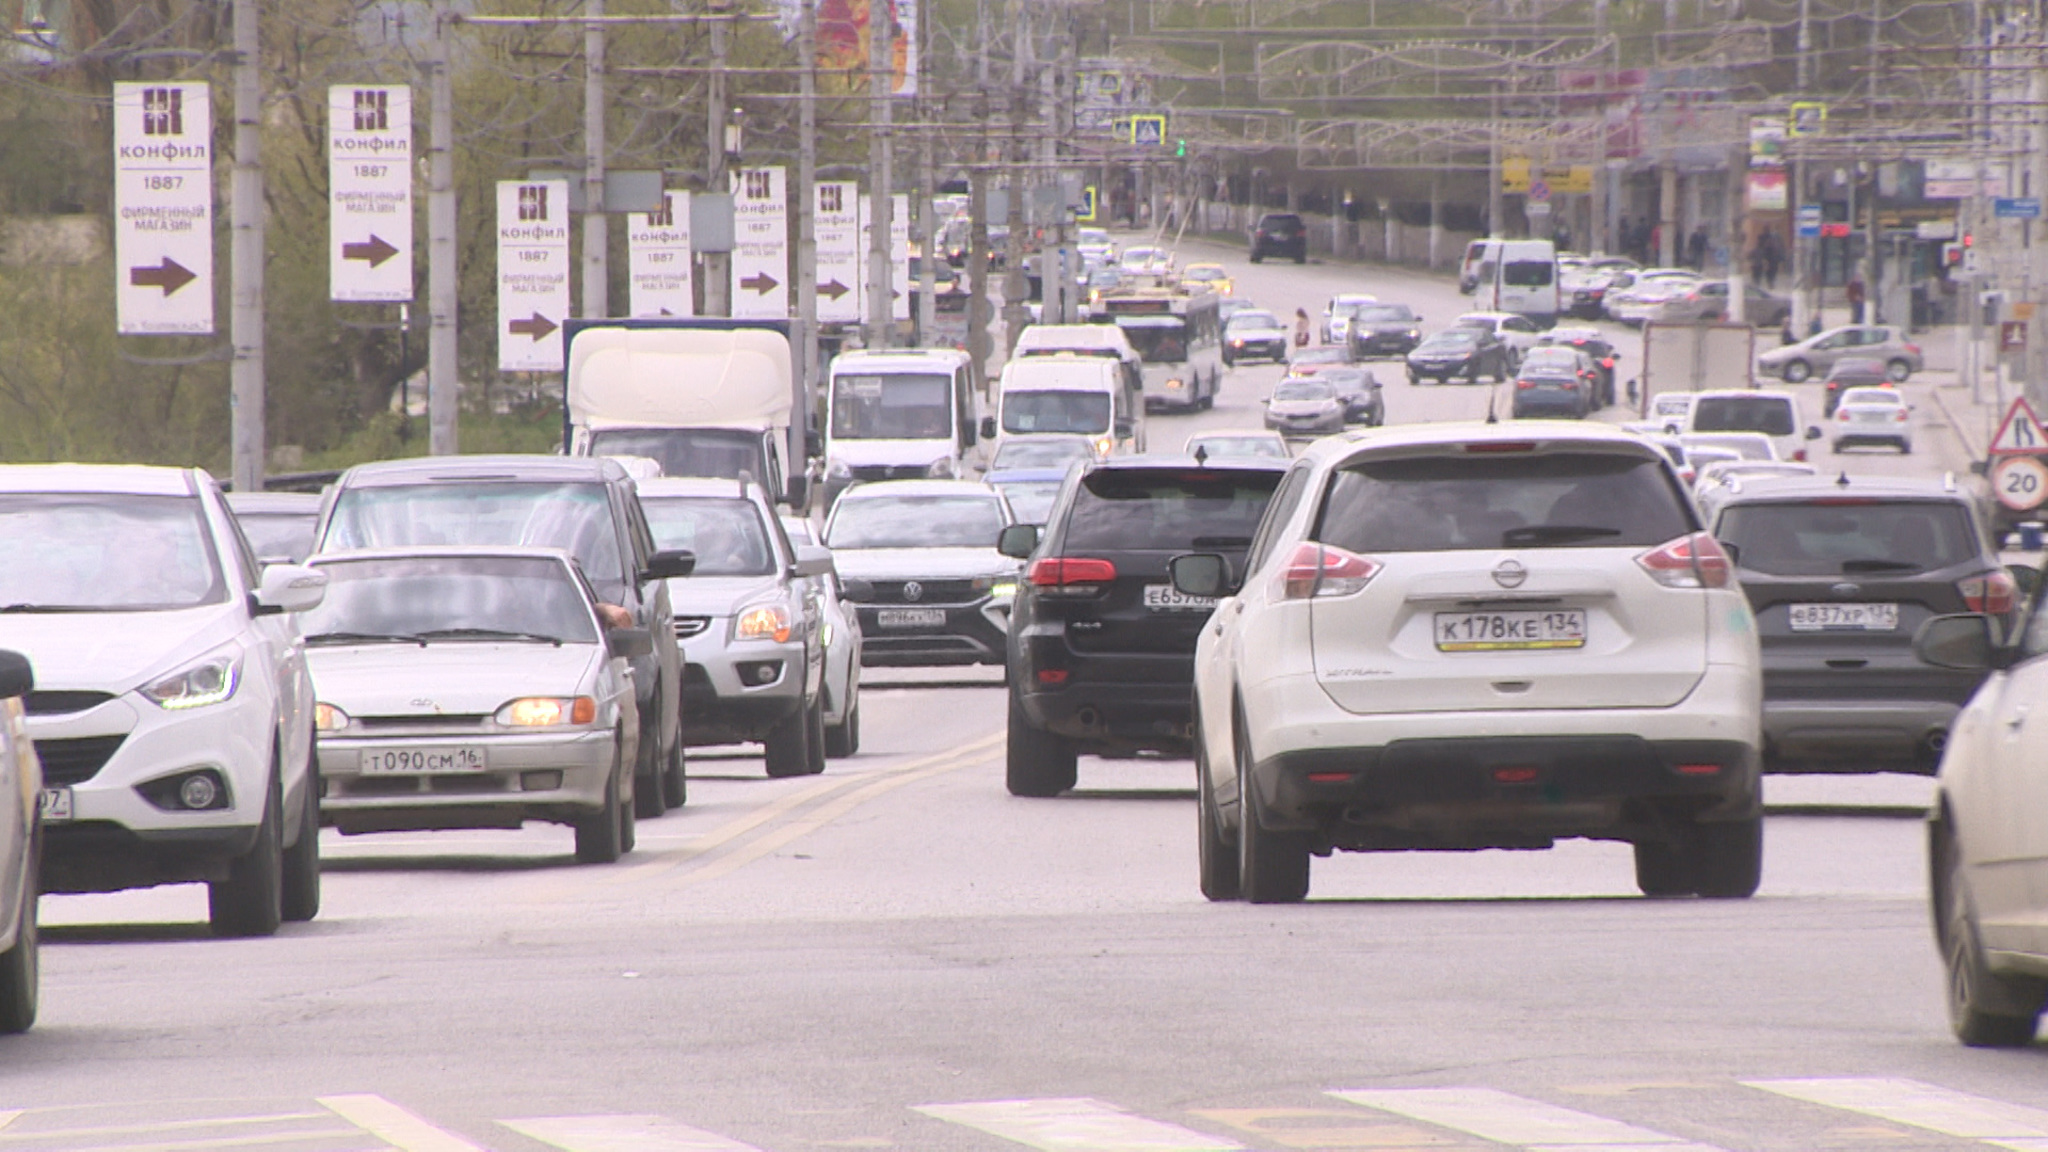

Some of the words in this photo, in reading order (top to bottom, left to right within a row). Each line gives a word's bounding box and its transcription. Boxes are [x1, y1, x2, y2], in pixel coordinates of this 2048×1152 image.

[120, 142, 205, 161] КОНФИЛ
[333, 136, 407, 153] КОНФИЛ
[353, 165, 388, 177] 1887
[144, 175, 184, 191] 1887
[121, 204, 206, 219] ФИРМЕННЫЙ
[134, 219, 193, 231] МАГАЗИН
[501, 225, 565, 241] КОНФИЛ
[519, 251, 549, 262] 1887
[2006, 472, 2038, 493] 20
[1543, 612, 1580, 631] 134
